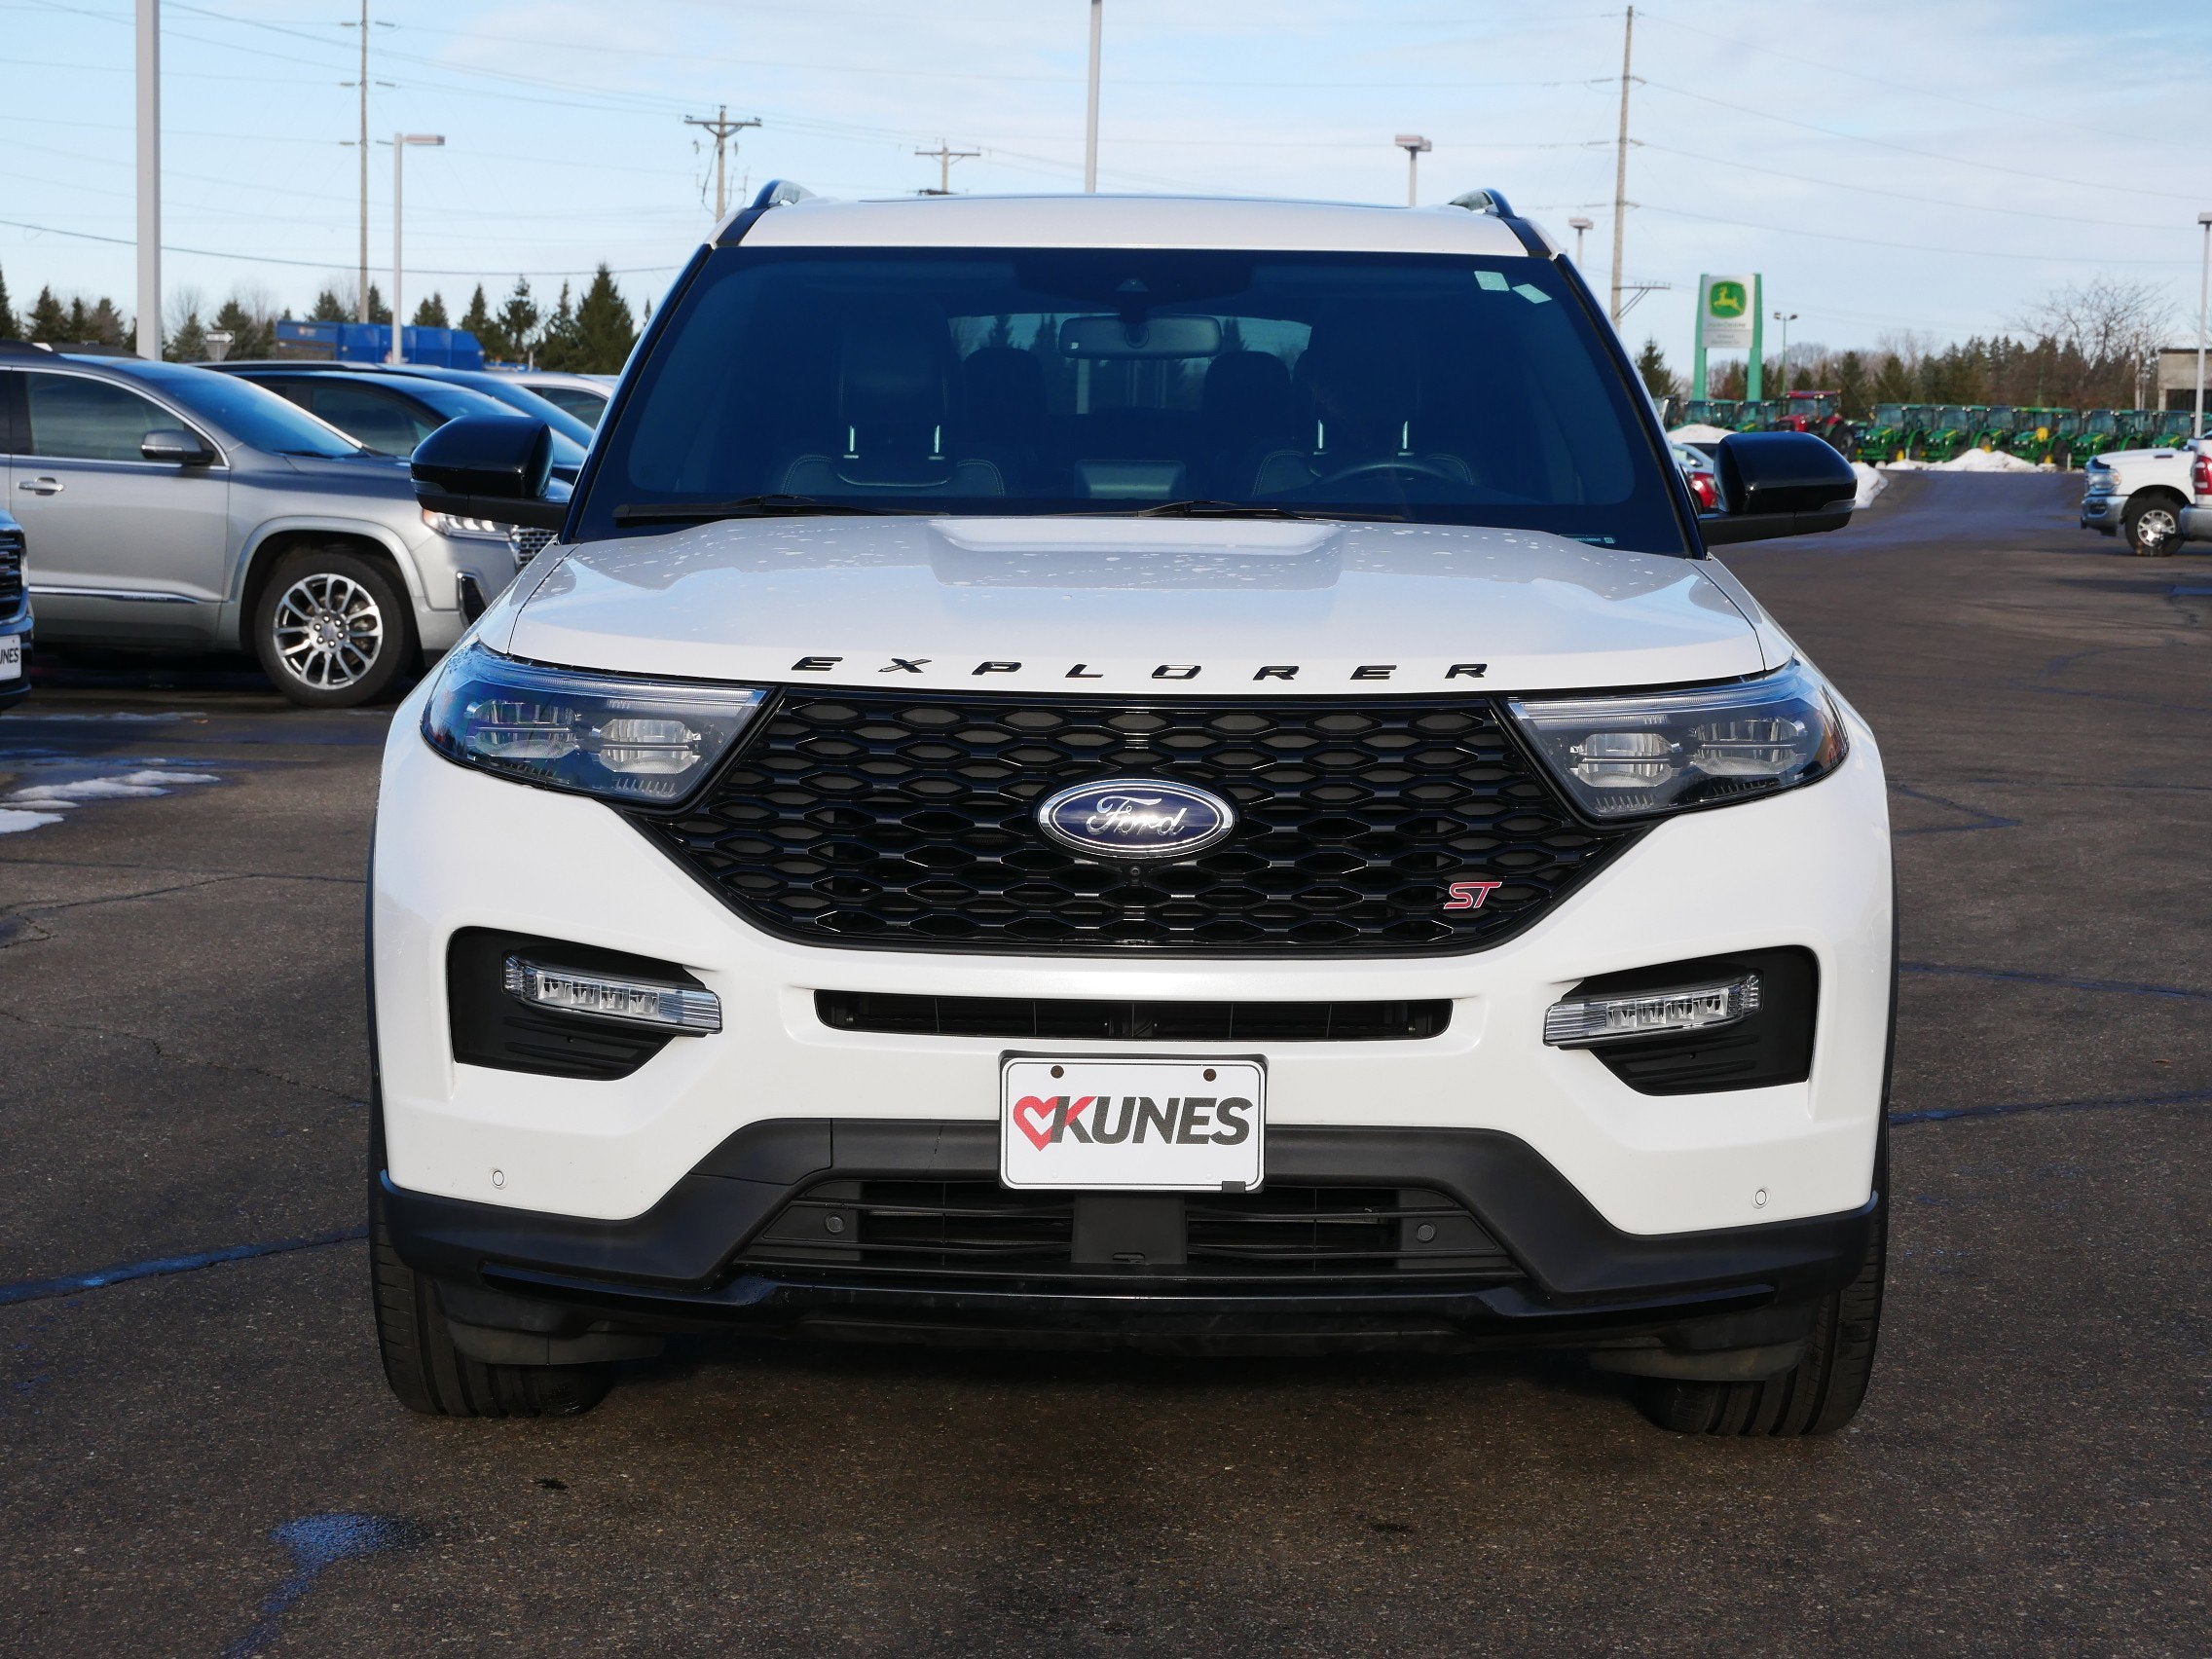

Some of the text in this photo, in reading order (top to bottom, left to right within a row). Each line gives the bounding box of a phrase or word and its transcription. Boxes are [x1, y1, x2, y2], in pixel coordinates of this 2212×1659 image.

[790, 655, 1489, 682] EXPLORER
[1086, 794, 1188, 835] Ford
[1443, 881, 1502, 909] ST
[1050, 1095, 1254, 1146] KUNES
